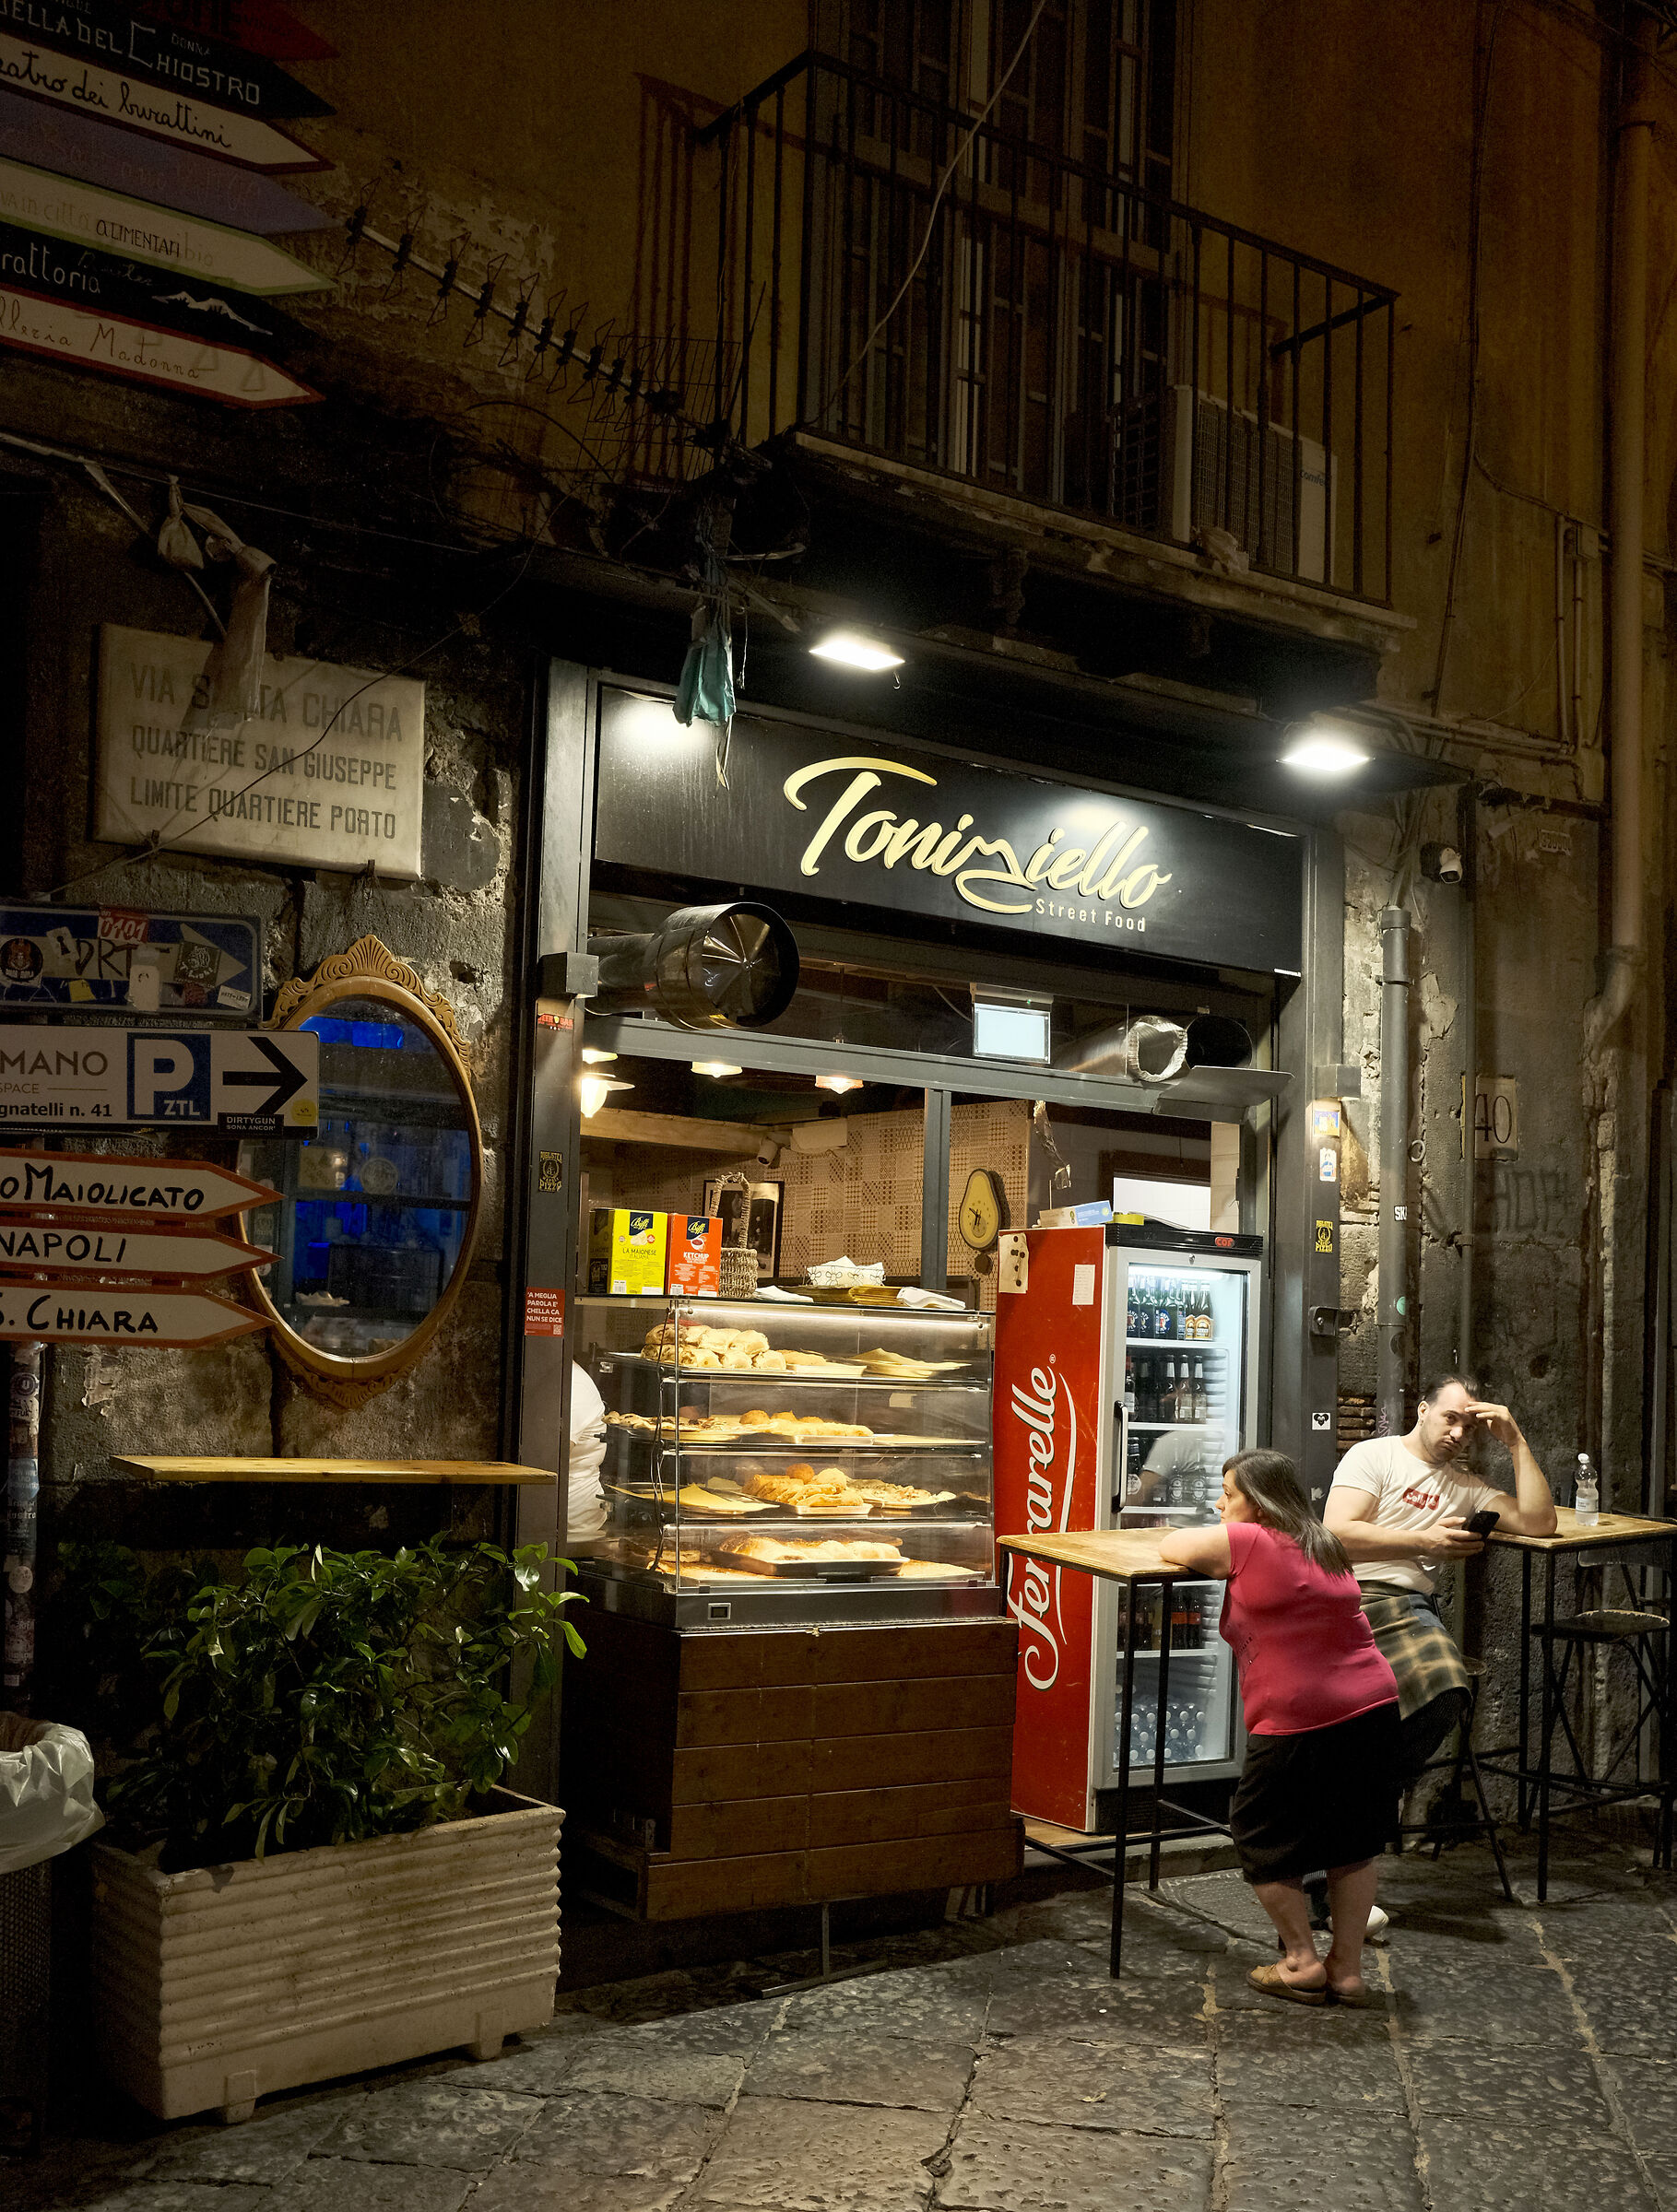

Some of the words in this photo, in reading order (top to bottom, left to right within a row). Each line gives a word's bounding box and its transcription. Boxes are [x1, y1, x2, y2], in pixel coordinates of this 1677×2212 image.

[72, 70, 109, 108] dei
[120, 82, 231, 148] burattini
[90, 323, 199, 380] Madonna
[131, 663, 175, 705] VIA
[302, 693, 403, 742] CHIARA
[131, 724, 245, 768] QUARTIERE
[254, 744, 295, 775] SAN
[303, 752, 396, 791] GIUSEPPE
[130, 777, 198, 813] LIMITE
[208, 788, 321, 830] QUARTIERE
[331, 806, 396, 841] PORTO
[1035, 898, 1097, 924] Street
[1104, 910, 1146, 933] Food
[134, 1039, 195, 1115] P
[90, 1103, 112, 1117] 41
[162, 1100, 201, 1116] ZTL
[226, 1116, 276, 1125] DIRTYGUN
[24, 1162, 205, 1211] MAIOLICATO
[0, 1231, 127, 1264] NAPOLI
[26, 1294, 159, 1334] CHIARA
[526, 1307, 550, 1315] CHELLA
